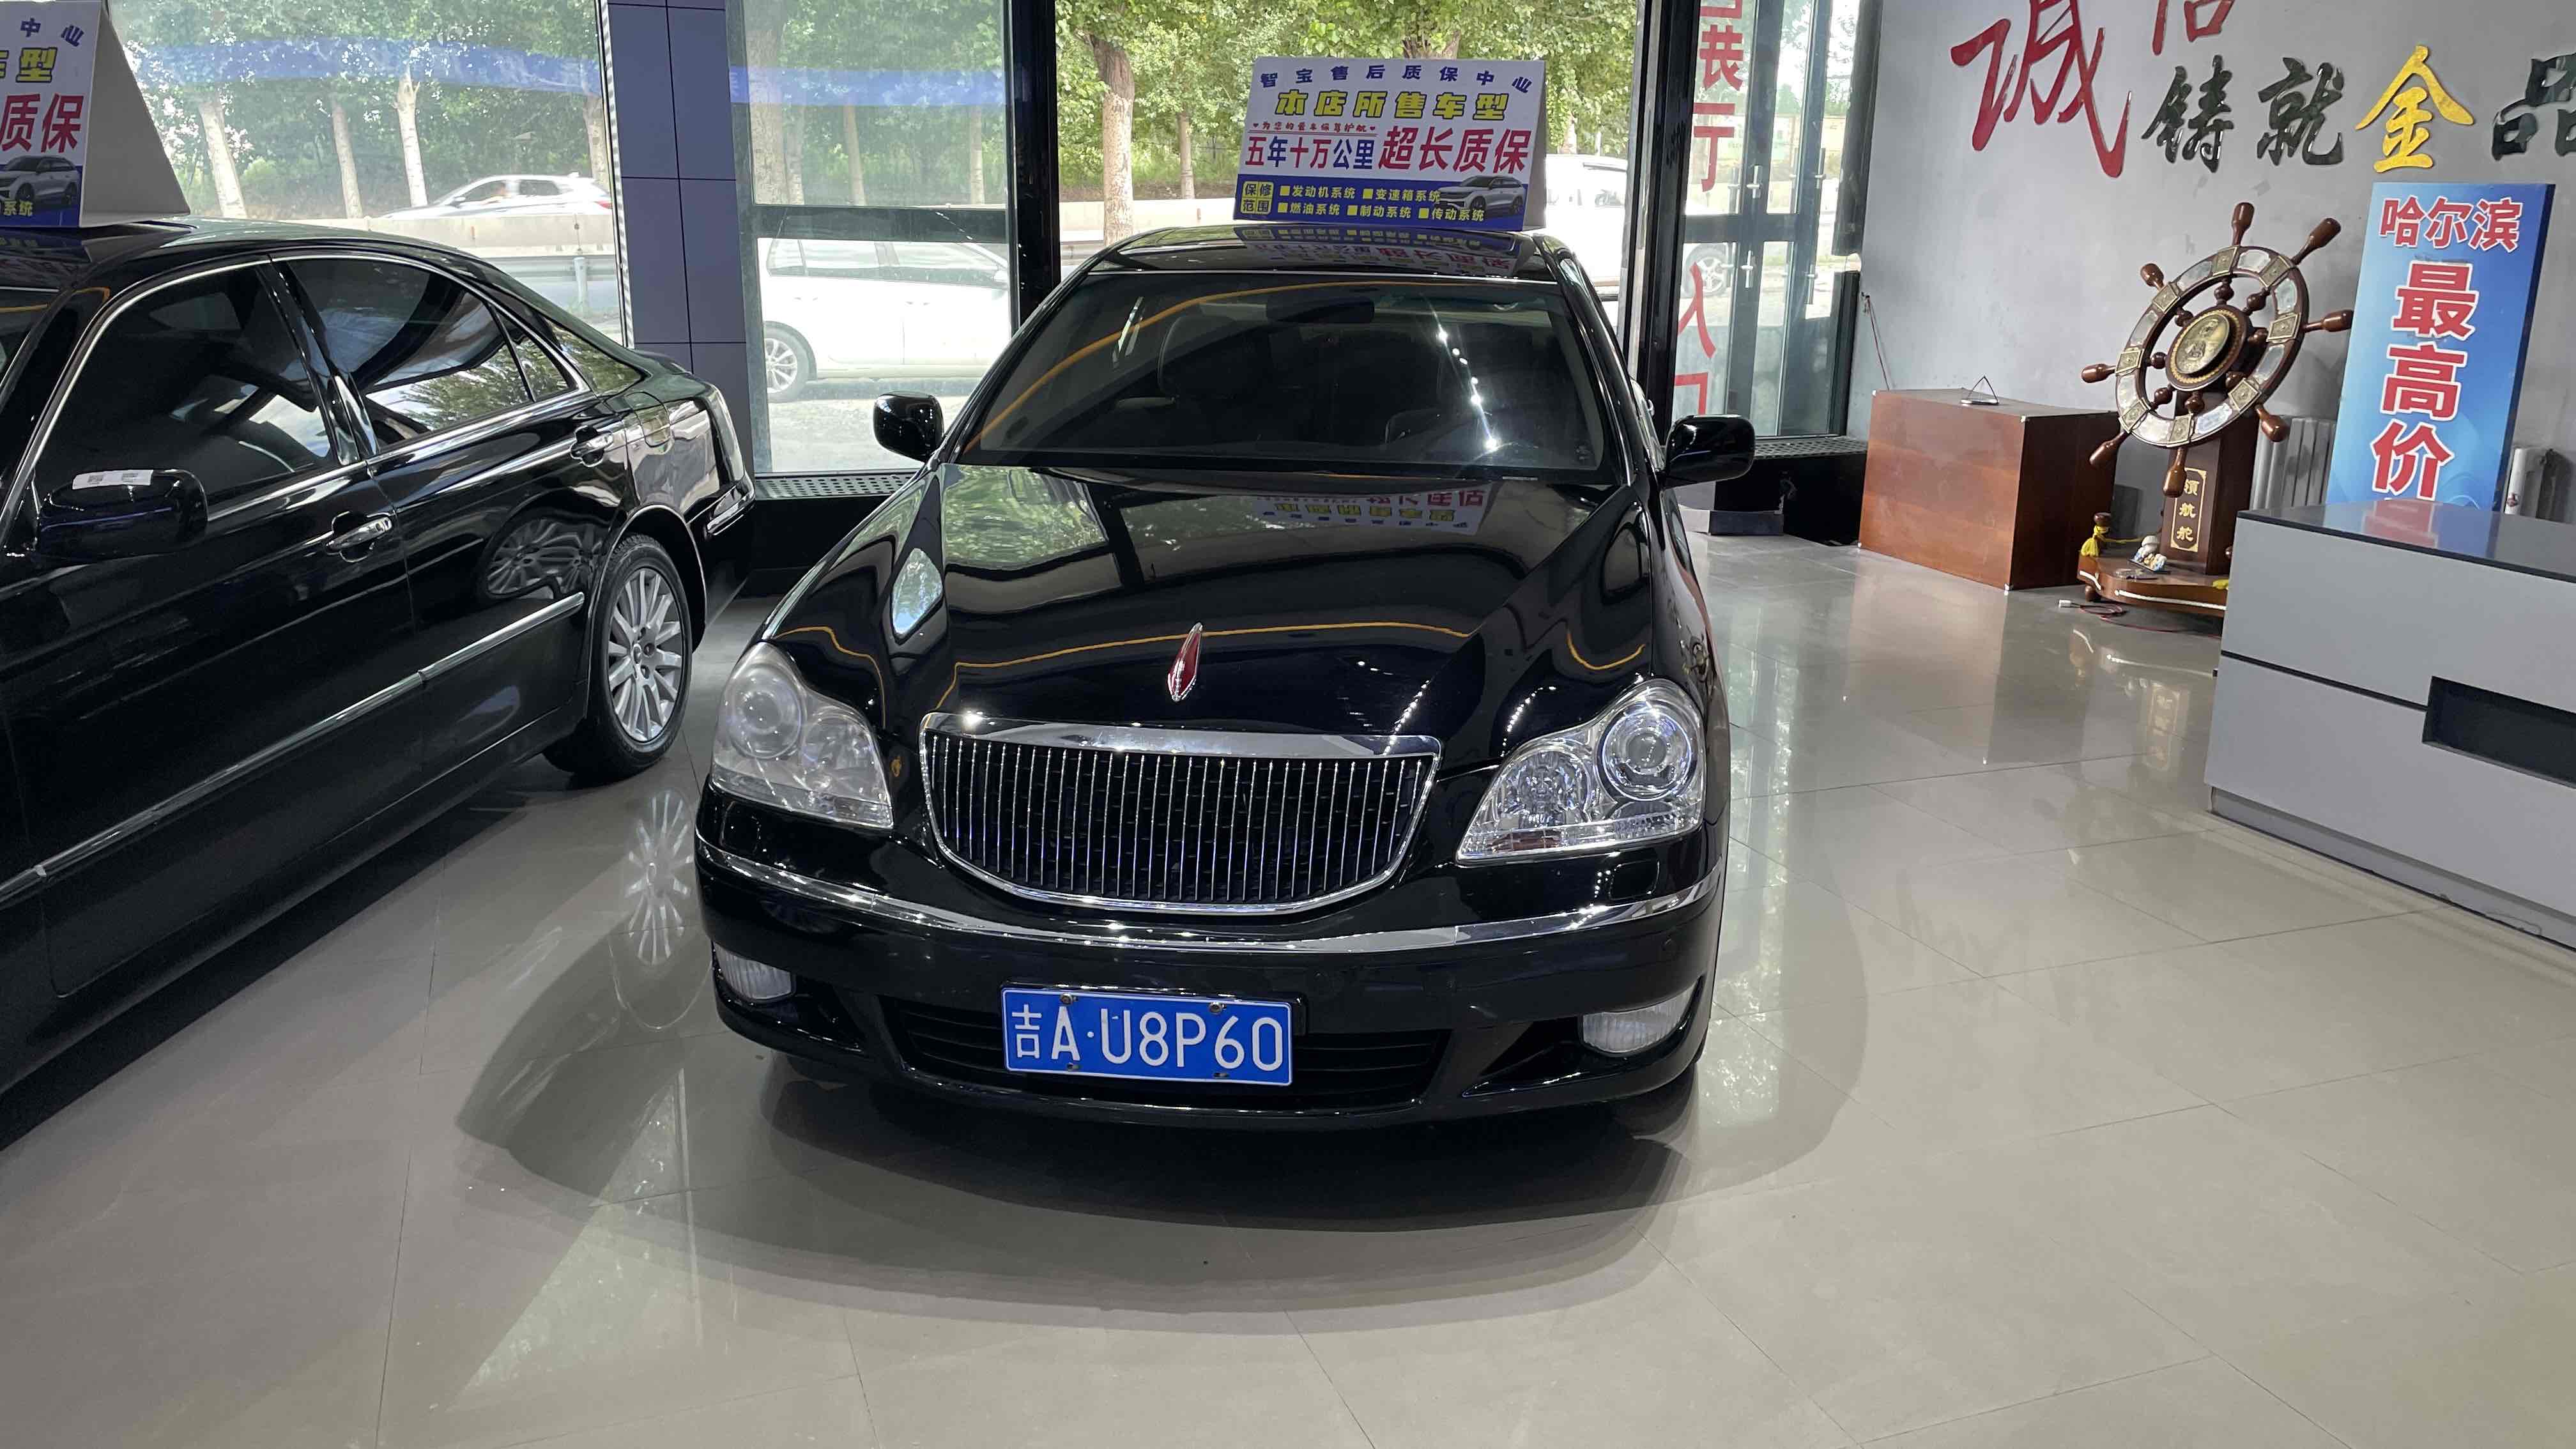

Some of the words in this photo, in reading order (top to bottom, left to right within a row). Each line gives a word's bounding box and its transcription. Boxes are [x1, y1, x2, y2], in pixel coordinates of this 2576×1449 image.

[20, 18, 84, 47] 中心
[1260, 65, 1533, 94] 智宝售后质保中心
[1275, 89, 1510, 121] 本店所售车型
[0, 93, 84, 153] 质保
[1245, 136, 1375, 170] 五年十万公里
[1378, 126, 1532, 174] 超长质保
[1245, 183, 1271, 197] 保修
[1292, 185, 1356, 199] 发动机系统
[1376, 188, 1441, 203] 变速箱系统
[0, 199, 33, 216] 系统
[1243, 199, 1270, 213] 范围
[1289, 202, 1340, 216] 燃油系统
[1360, 204, 1411, 219] 制动系统
[1431, 207, 1485, 222] 传动系统
[2379, 197, 2523, 252] 哈尔滨
[2371, 259, 2480, 502] 最高价
